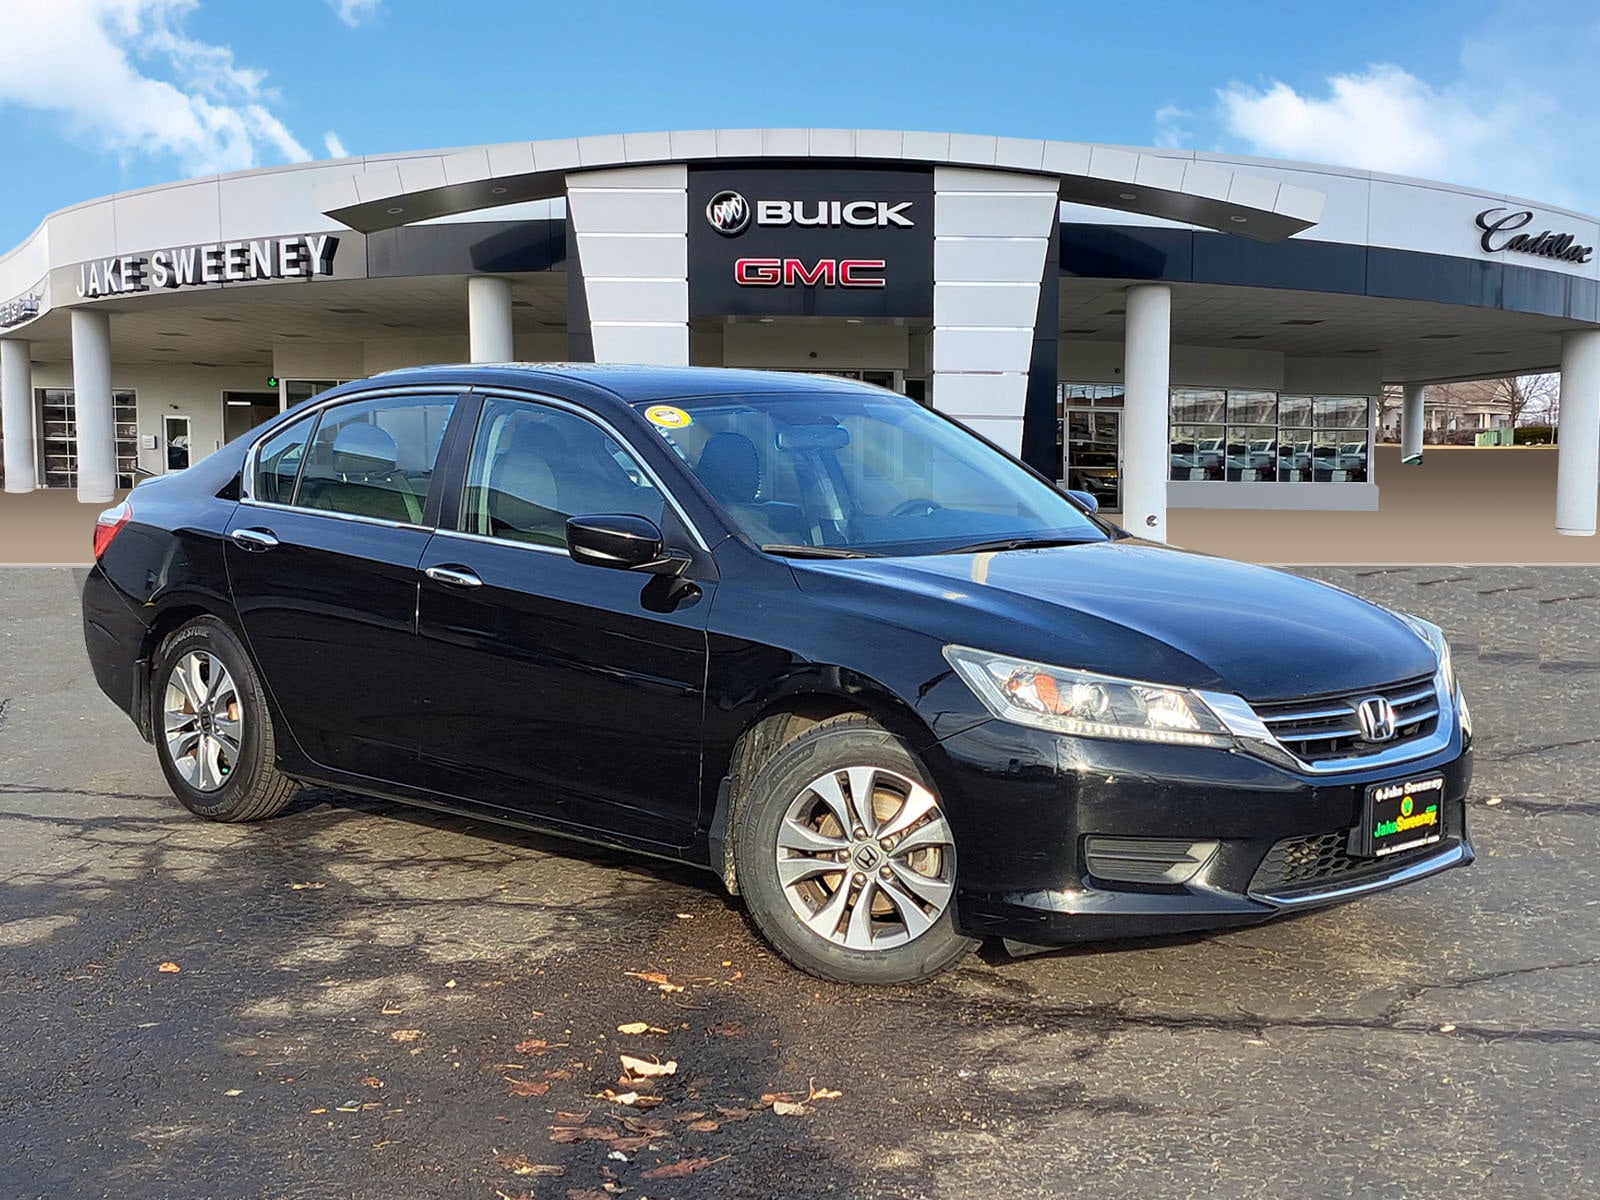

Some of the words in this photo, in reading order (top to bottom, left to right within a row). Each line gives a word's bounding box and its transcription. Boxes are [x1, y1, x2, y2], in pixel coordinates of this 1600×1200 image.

[757, 200, 915, 226] BUICK
[1475, 207, 1593, 263] Cadillac
[77, 257, 147, 298] JAKE
[151, 235, 336, 288] SWEENEY
[734, 258, 886, 287] GMC
